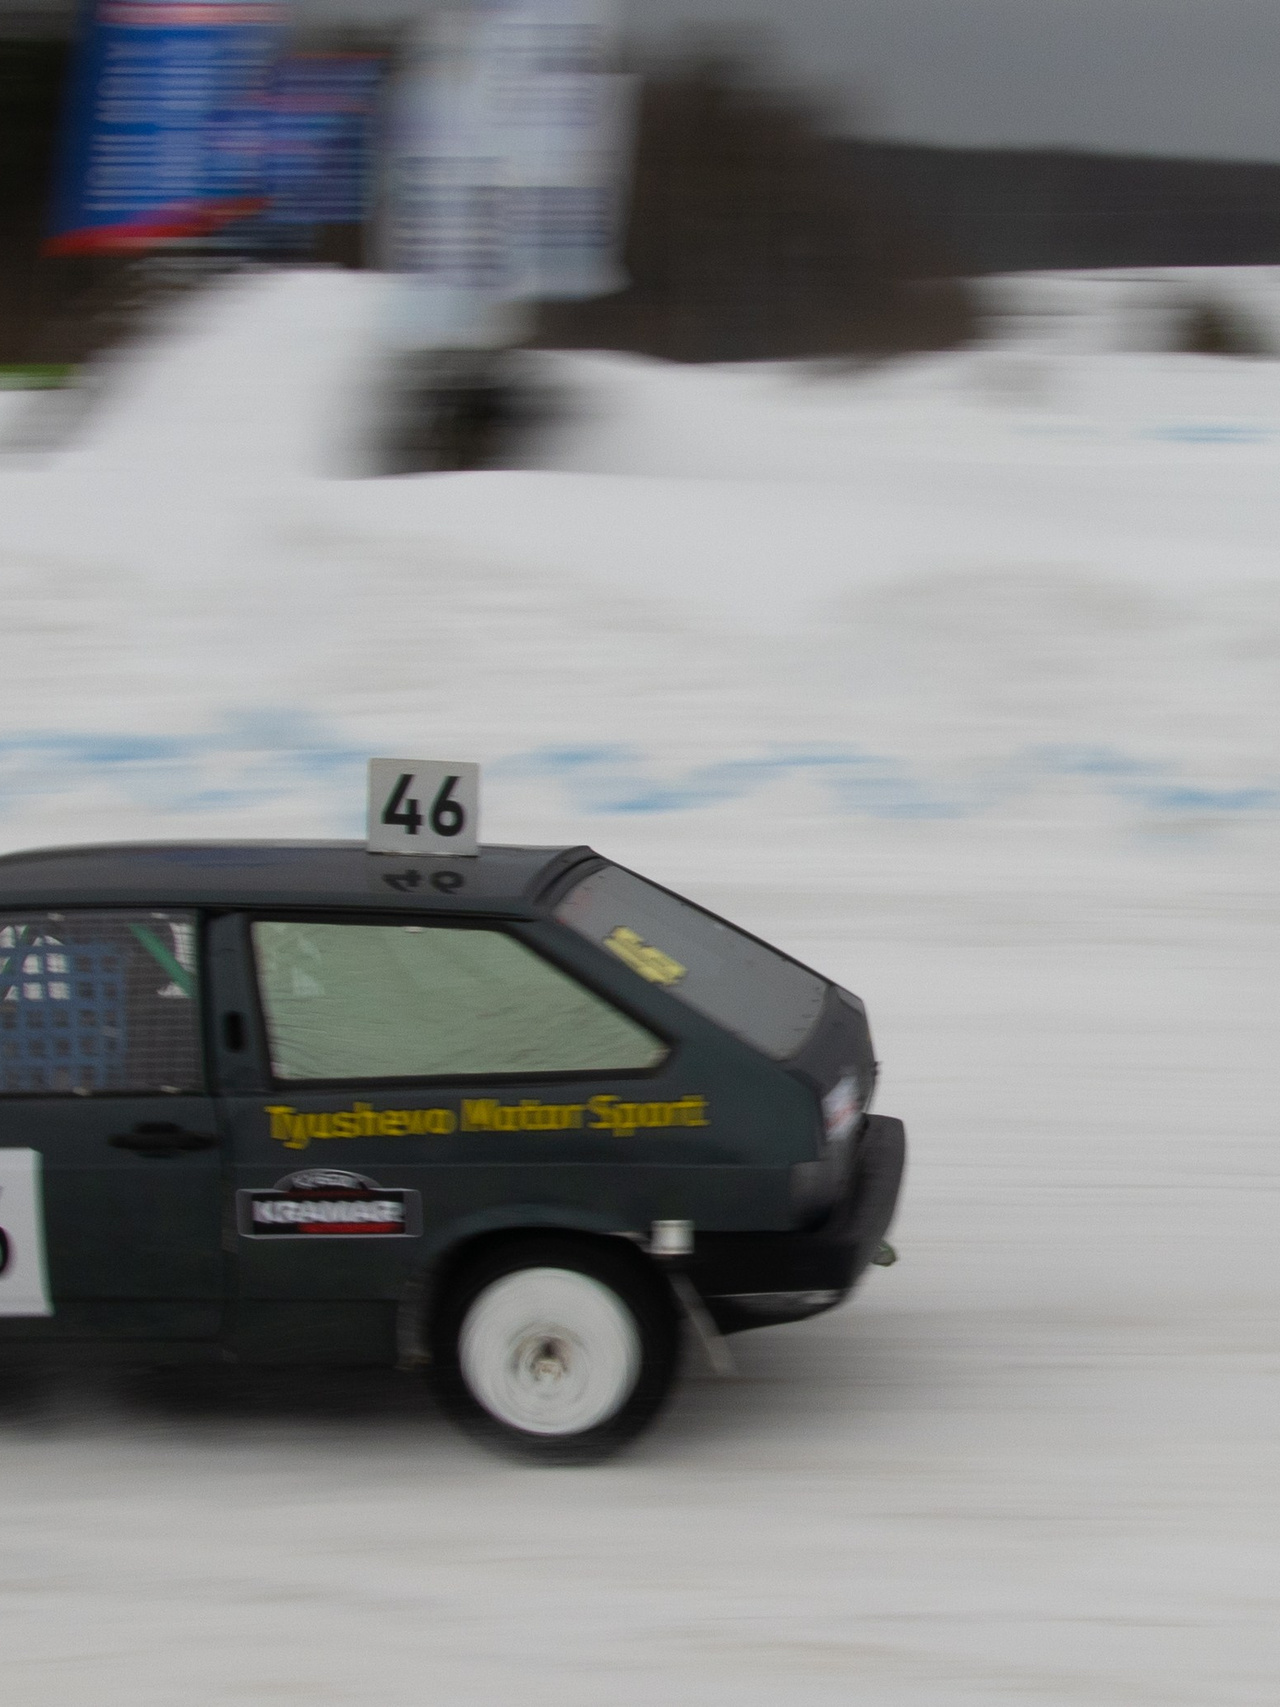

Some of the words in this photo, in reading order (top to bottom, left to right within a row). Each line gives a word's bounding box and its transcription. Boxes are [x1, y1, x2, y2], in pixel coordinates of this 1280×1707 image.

[381, 773, 465, 836] 46
[461, 1098, 583, 1133] Motor
[588, 1095, 711, 1137] Sport
